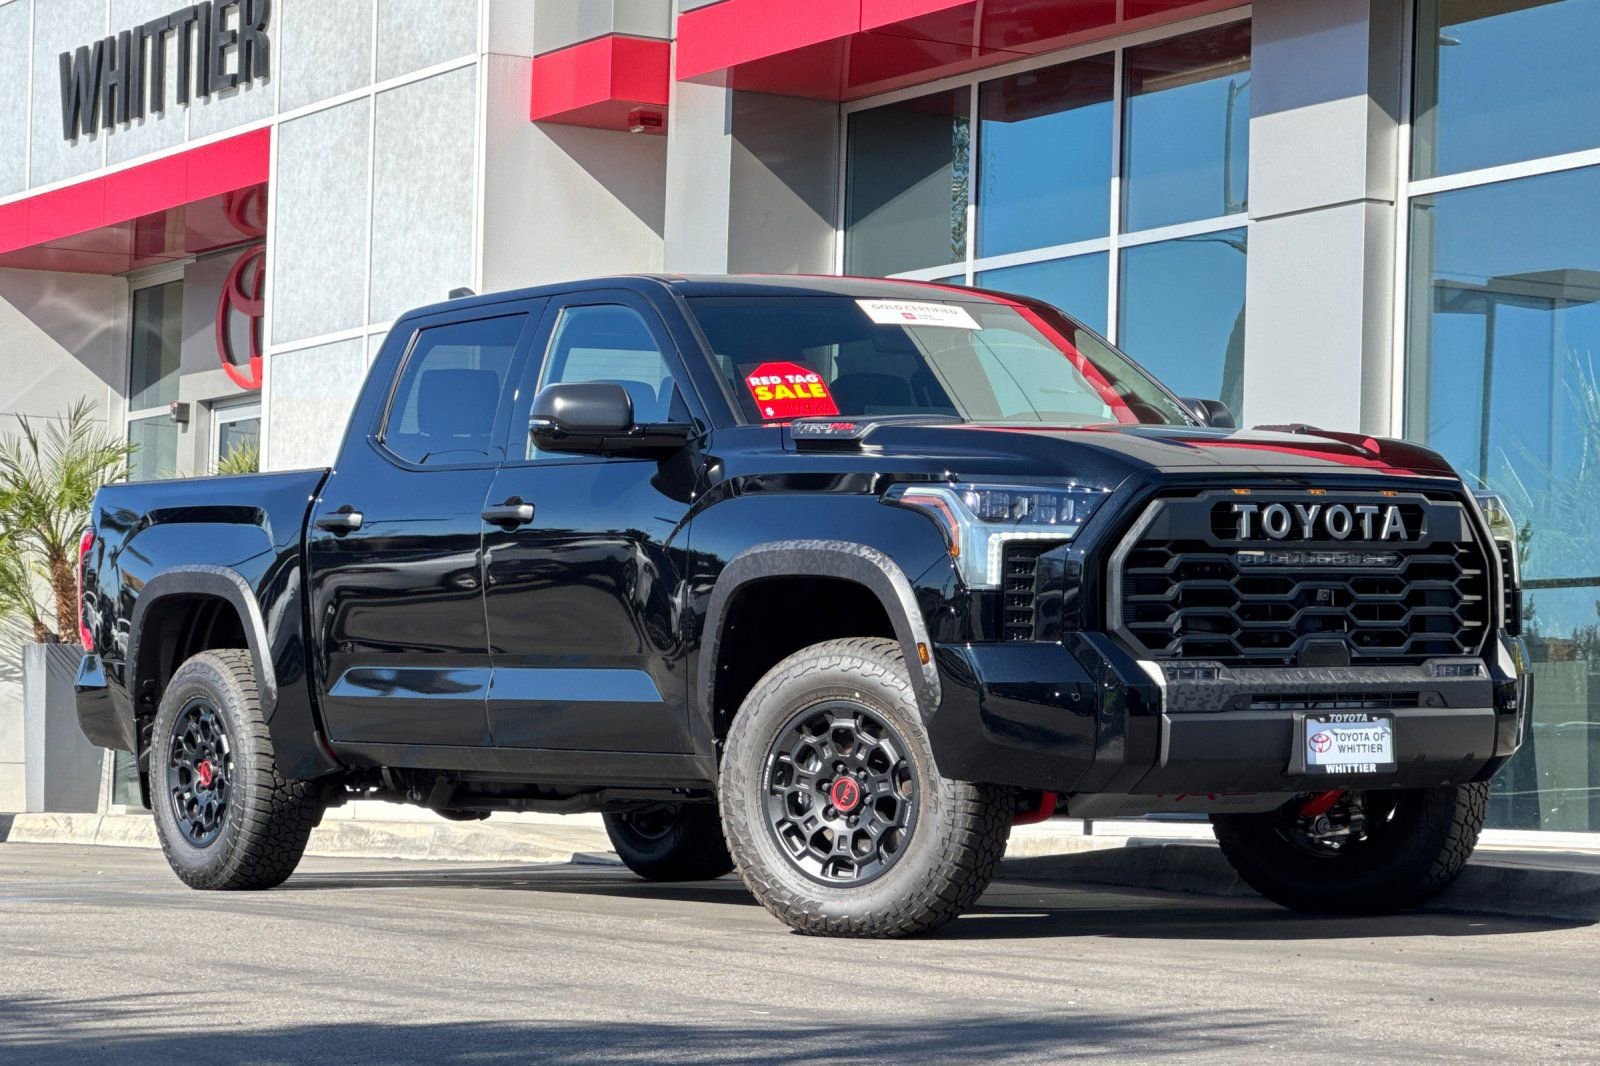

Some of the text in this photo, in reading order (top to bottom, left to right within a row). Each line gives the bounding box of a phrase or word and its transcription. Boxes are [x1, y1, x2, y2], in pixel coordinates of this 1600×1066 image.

[59, 0, 271, 141] WHITTIER
[749, 374, 819, 387] RED TAG
[755, 383, 828, 401] SALE
[1231, 503, 1408, 540] TOYOTA
[1329, 713, 1368, 722] TOYOTA
[1335, 732, 1386, 742] TOYOTA OF
[1338, 744, 1383, 753] WHITTIER
[1326, 763, 1377, 774] WHITTIER
